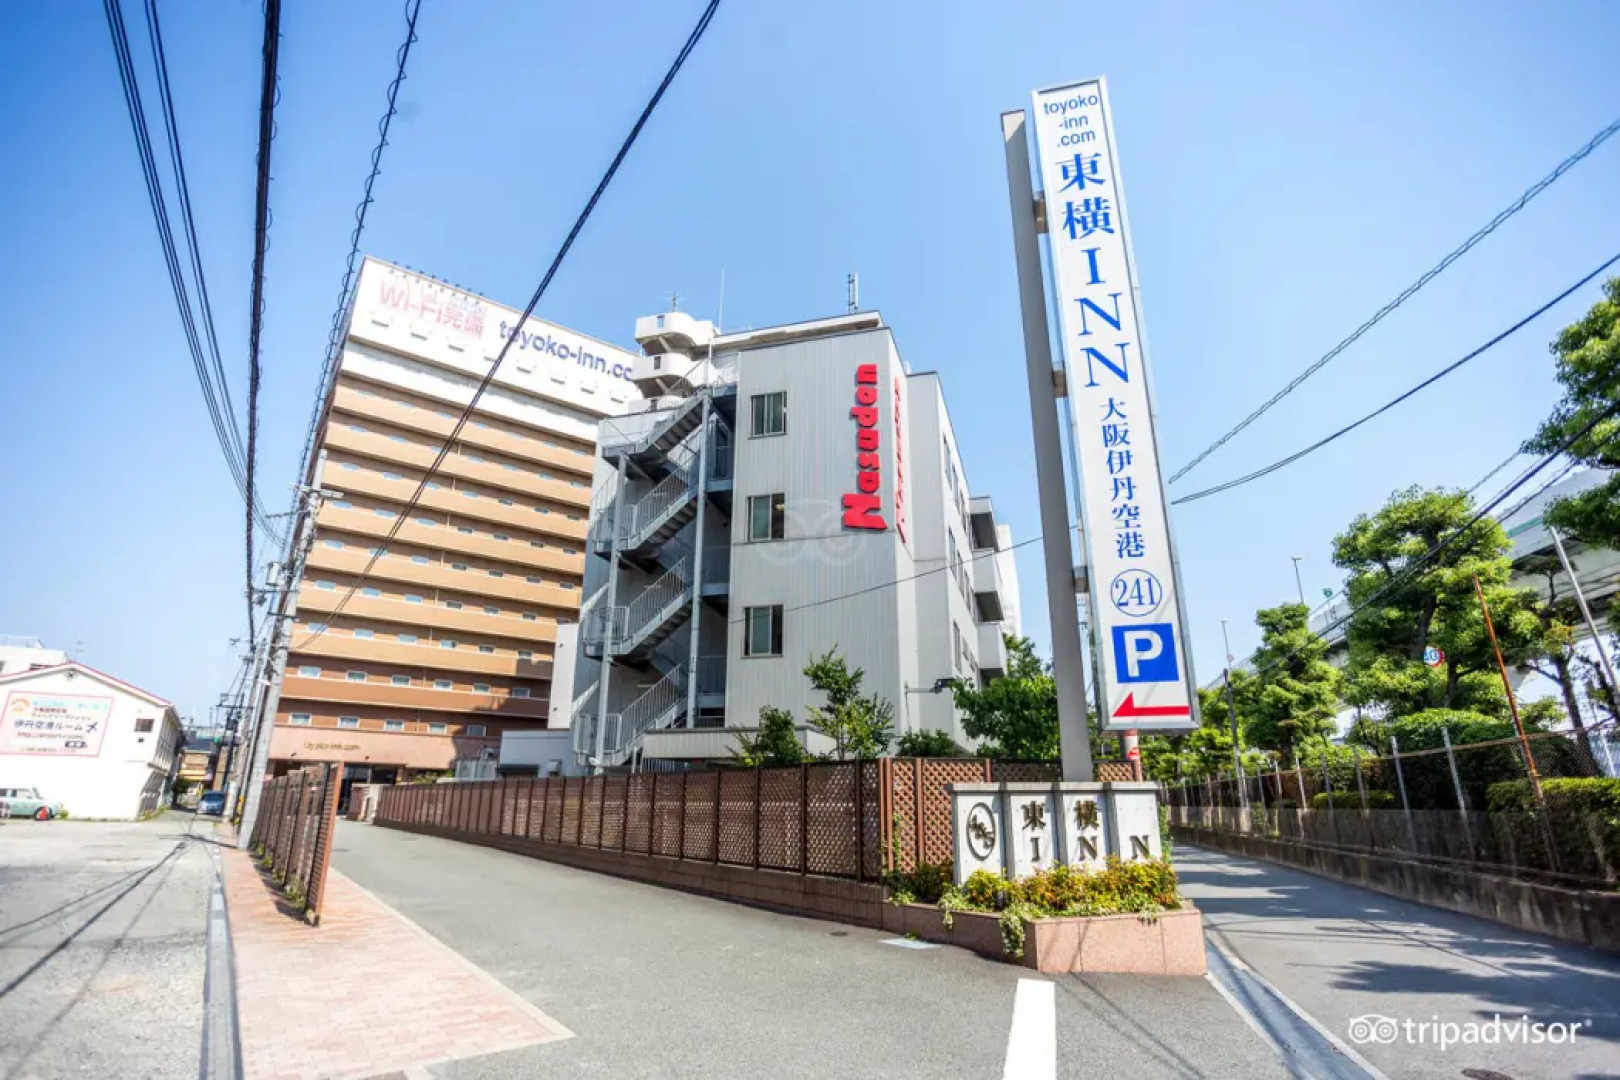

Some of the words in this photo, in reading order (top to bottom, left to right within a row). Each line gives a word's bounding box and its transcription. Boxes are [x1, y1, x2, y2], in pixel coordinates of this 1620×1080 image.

[1044, 95, 1098, 115] toyoko
[1058, 115, 1089, 129] -inn
[1057, 130, 1096, 148] .com
[1055, 152, 1130, 388] 東横INN
[842, 364, 888, 529] Nasudan
[1100, 397, 1145, 559] 大阪伊丹空港
[1114, 577, 1156, 607] 241
[1123, 630, 1163, 677] P
[1021, 800, 1099, 831] 東横
[1030, 834, 1151, 862] INN
